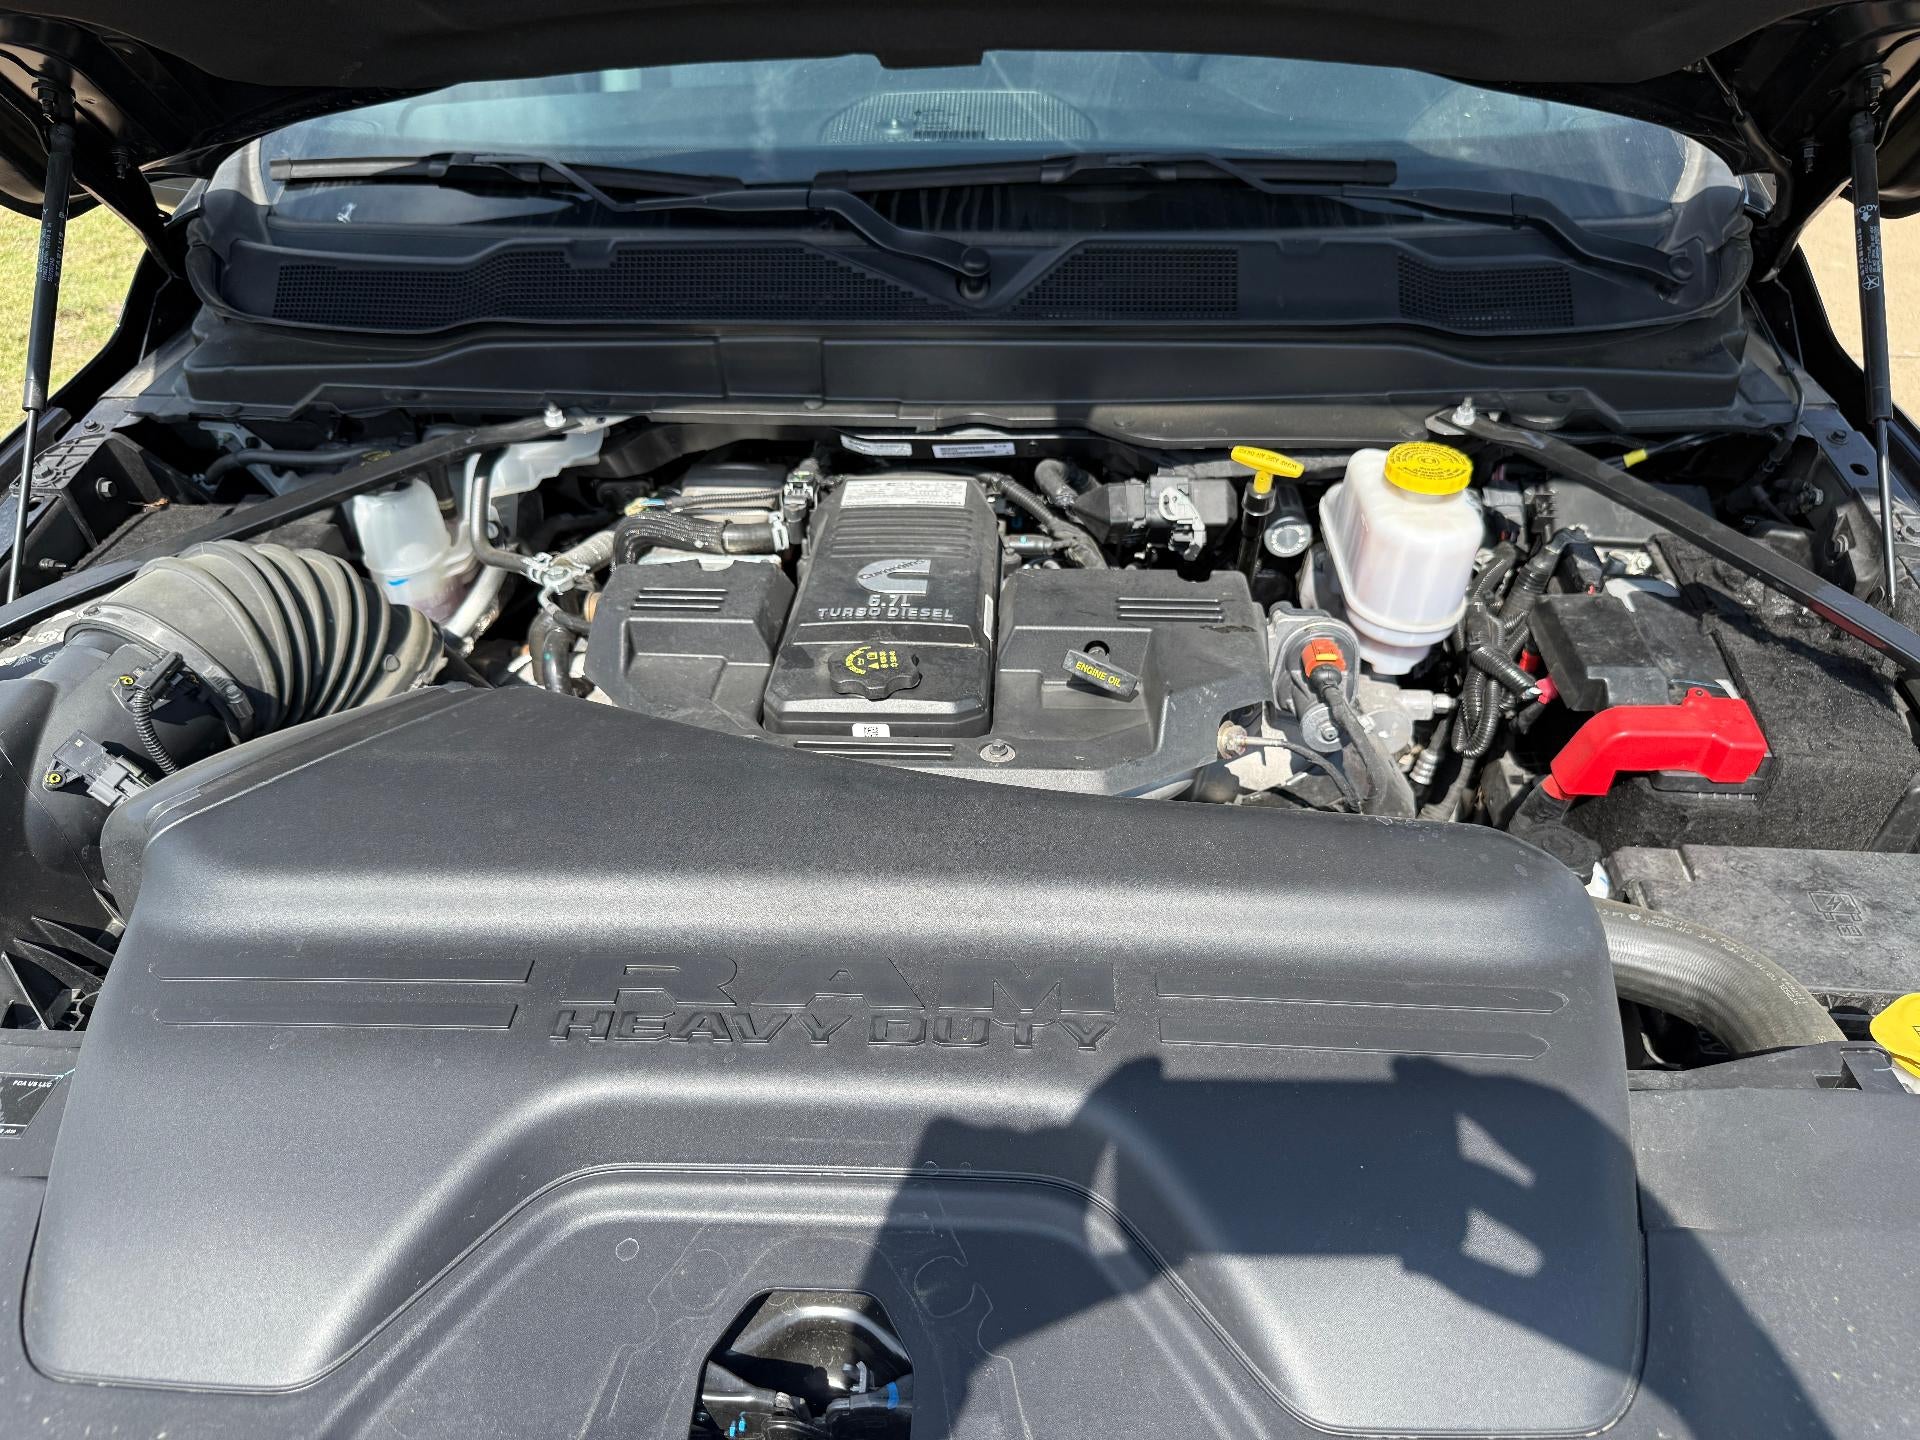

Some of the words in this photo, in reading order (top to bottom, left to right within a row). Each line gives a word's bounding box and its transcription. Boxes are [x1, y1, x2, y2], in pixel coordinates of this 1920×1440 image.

[1856, 204, 1878, 214] ODY
[868, 594, 911, 607] 6.7L
[817, 607, 881, 618] TURBO
[887, 608, 954, 619] DIESEL
[1075, 661, 1107, 681] ENGINE
[1107, 675, 1121, 688] OIL
[559, 951, 1114, 1014] RAM
[550, 1009, 853, 1046] HEAVY
[867, 1015, 1118, 1050] DUTY
